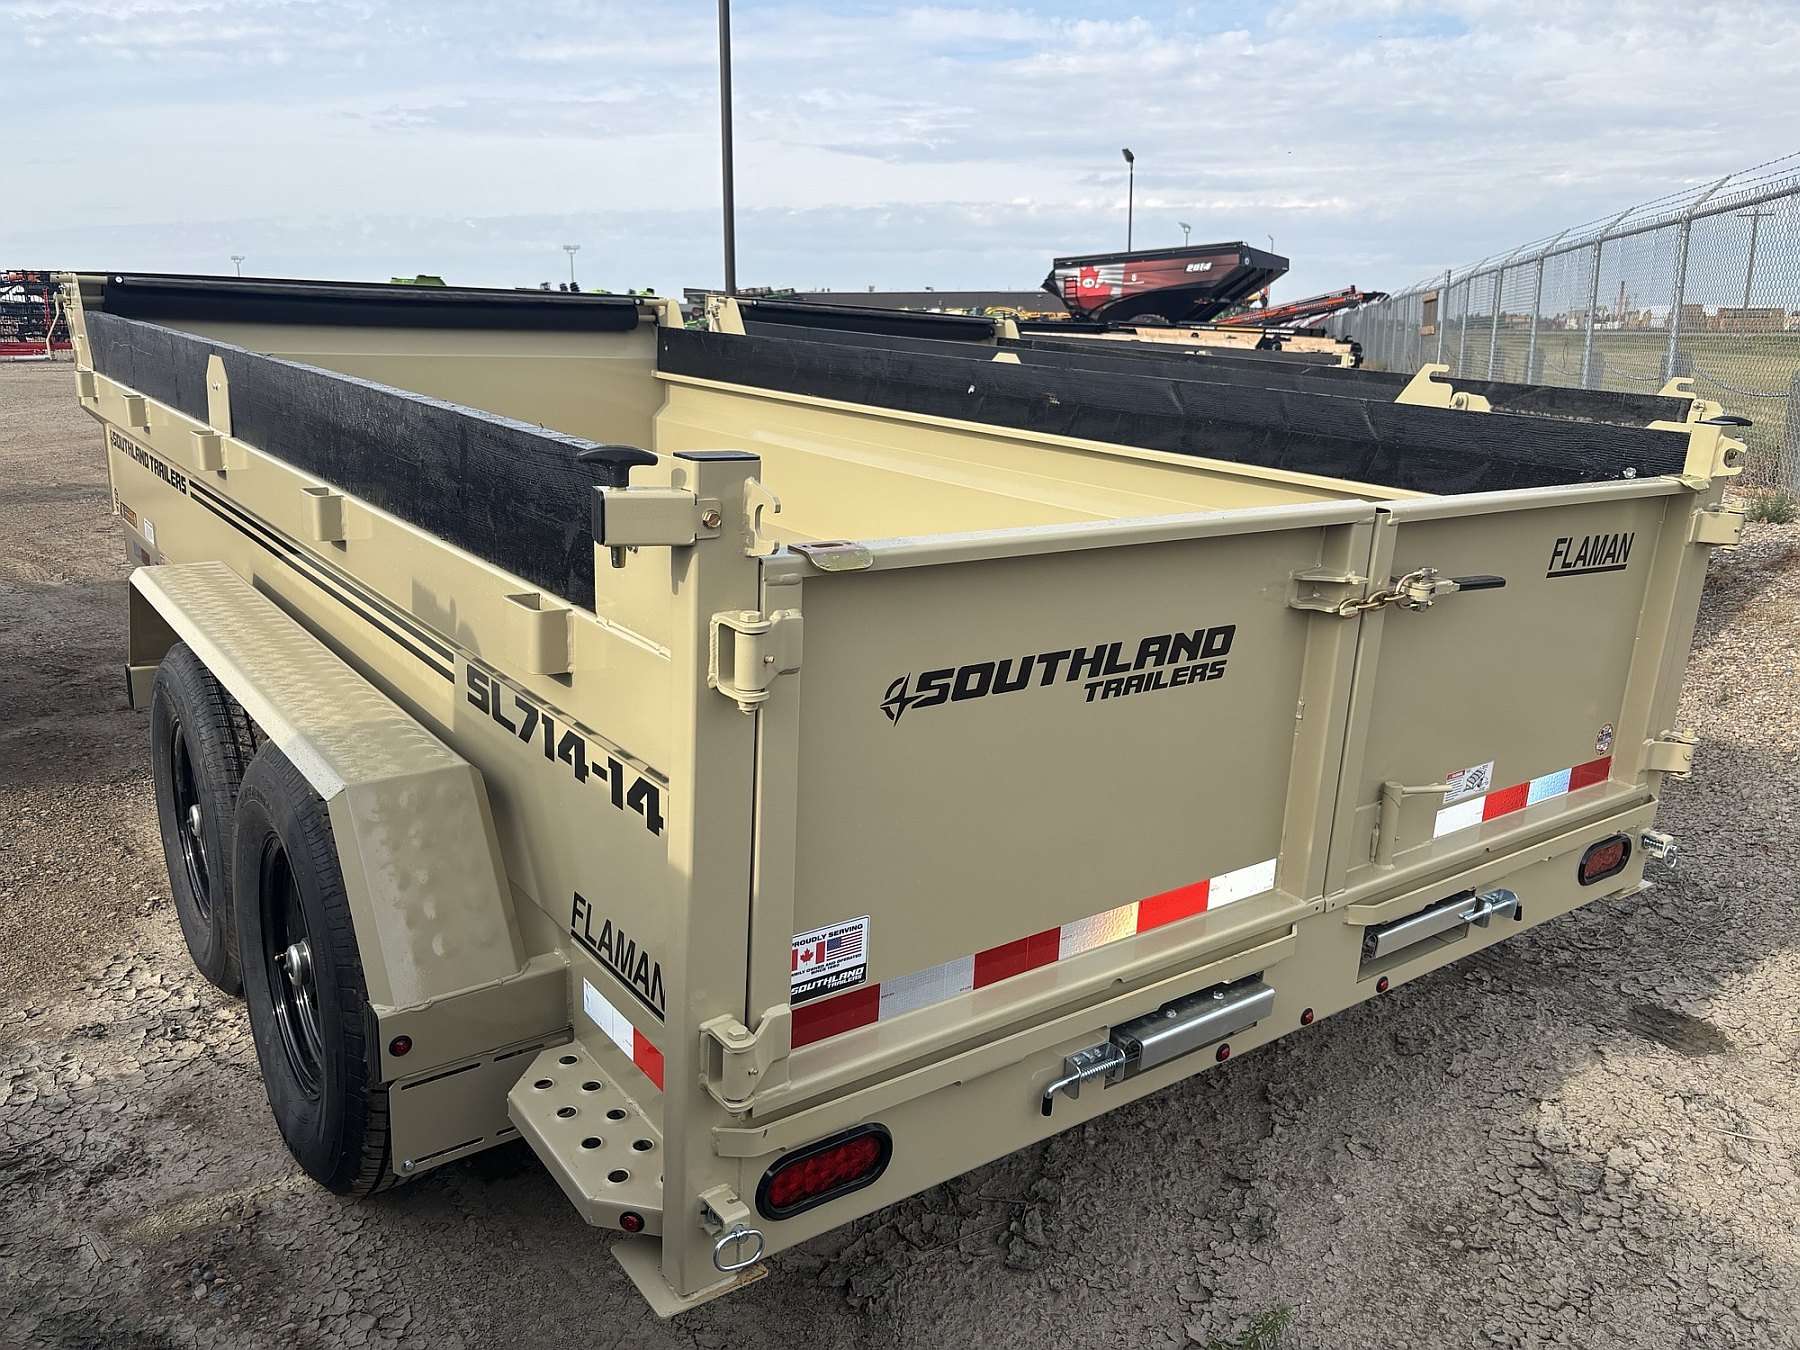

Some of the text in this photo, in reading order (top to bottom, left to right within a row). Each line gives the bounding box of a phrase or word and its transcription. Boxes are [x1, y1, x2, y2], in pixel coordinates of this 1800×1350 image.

[112, 431, 187, 495] SOUTHLAND TRAILERS
[1548, 532, 1635, 571] FLAMAN
[911, 624, 1236, 709] SOUTHLAND
[1084, 660, 1227, 703] TRAILERS
[466, 663, 664, 836] SL714-14
[571, 890, 665, 1012] FLAMAN
[828, 923, 863, 937] SERVING
[791, 967, 865, 995] SOUTHLAND
[827, 974, 862, 989] TRAILERS
